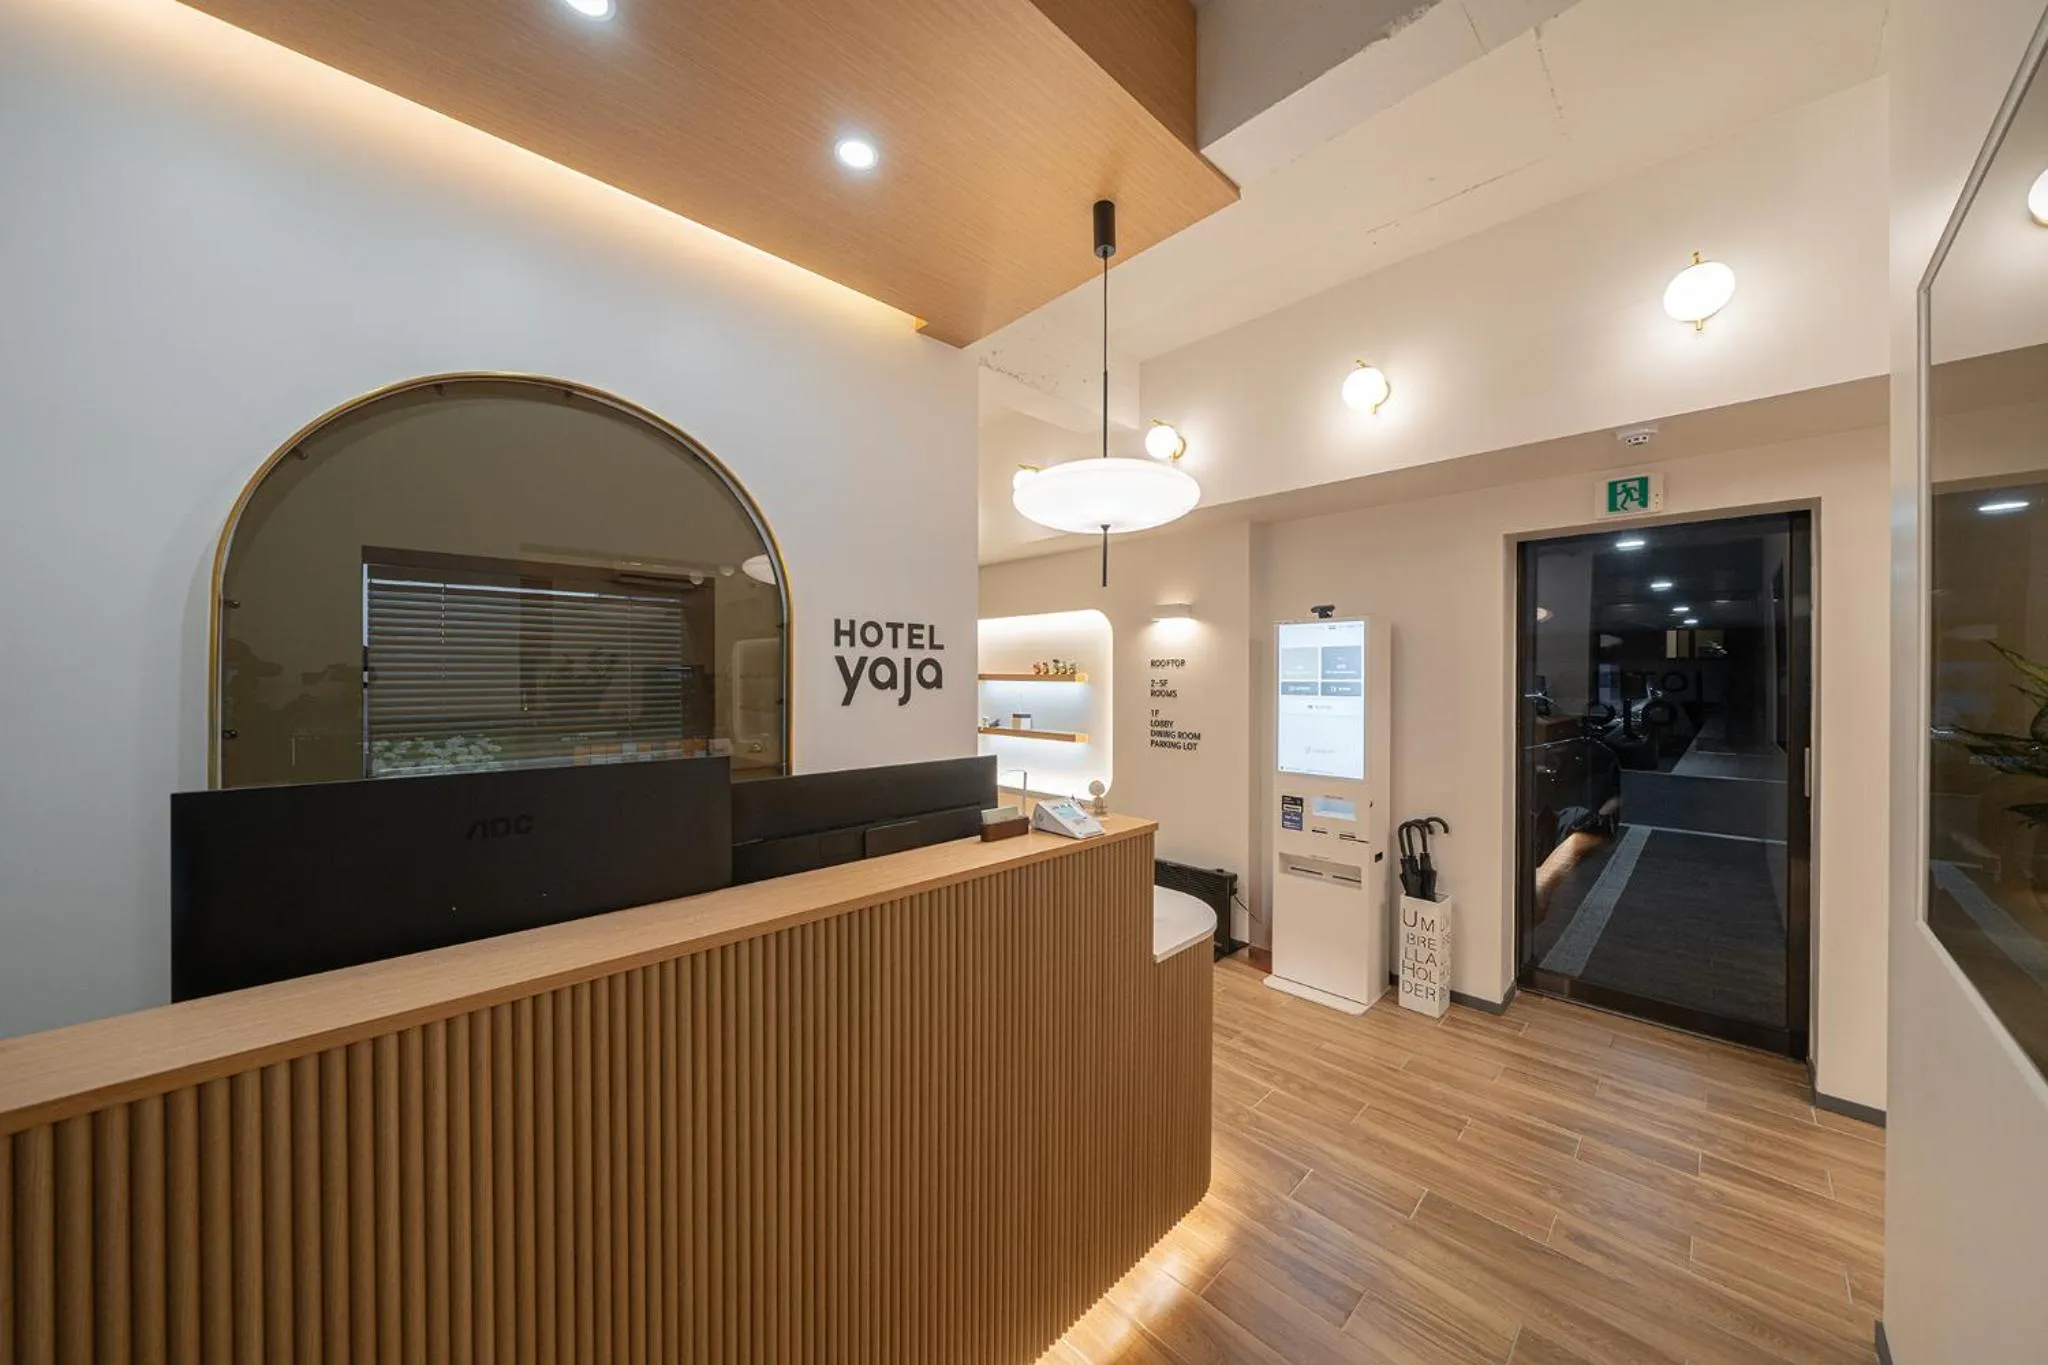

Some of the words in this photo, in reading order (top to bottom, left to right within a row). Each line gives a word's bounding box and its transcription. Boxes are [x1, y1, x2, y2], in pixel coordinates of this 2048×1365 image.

[834, 618, 945, 650] HOTEL
[1150, 659, 1186, 668] ROOFTOP
[834, 655, 943, 706] yaja
[1150, 679, 1168, 688] 2-5F
[1150, 689, 1178, 698] ROOMS
[1150, 709, 1160, 717] 1F
[1150, 720, 1174, 728] LOBBY
[1150, 730, 1176, 739] DINING
[1178, 731, 1201, 740] ROOM
[1150, 739, 1182, 750] PARKING
[1183, 742, 1198, 751] LOT
[465, 812, 534, 840] AOC
[1402, 907, 1435, 932] UM
[1406, 932, 1437, 951] BRE
[1405, 947, 1437, 967] LLA
[1402, 959, 1437, 985] HOL
[1402, 980, 1436, 1002] DER
